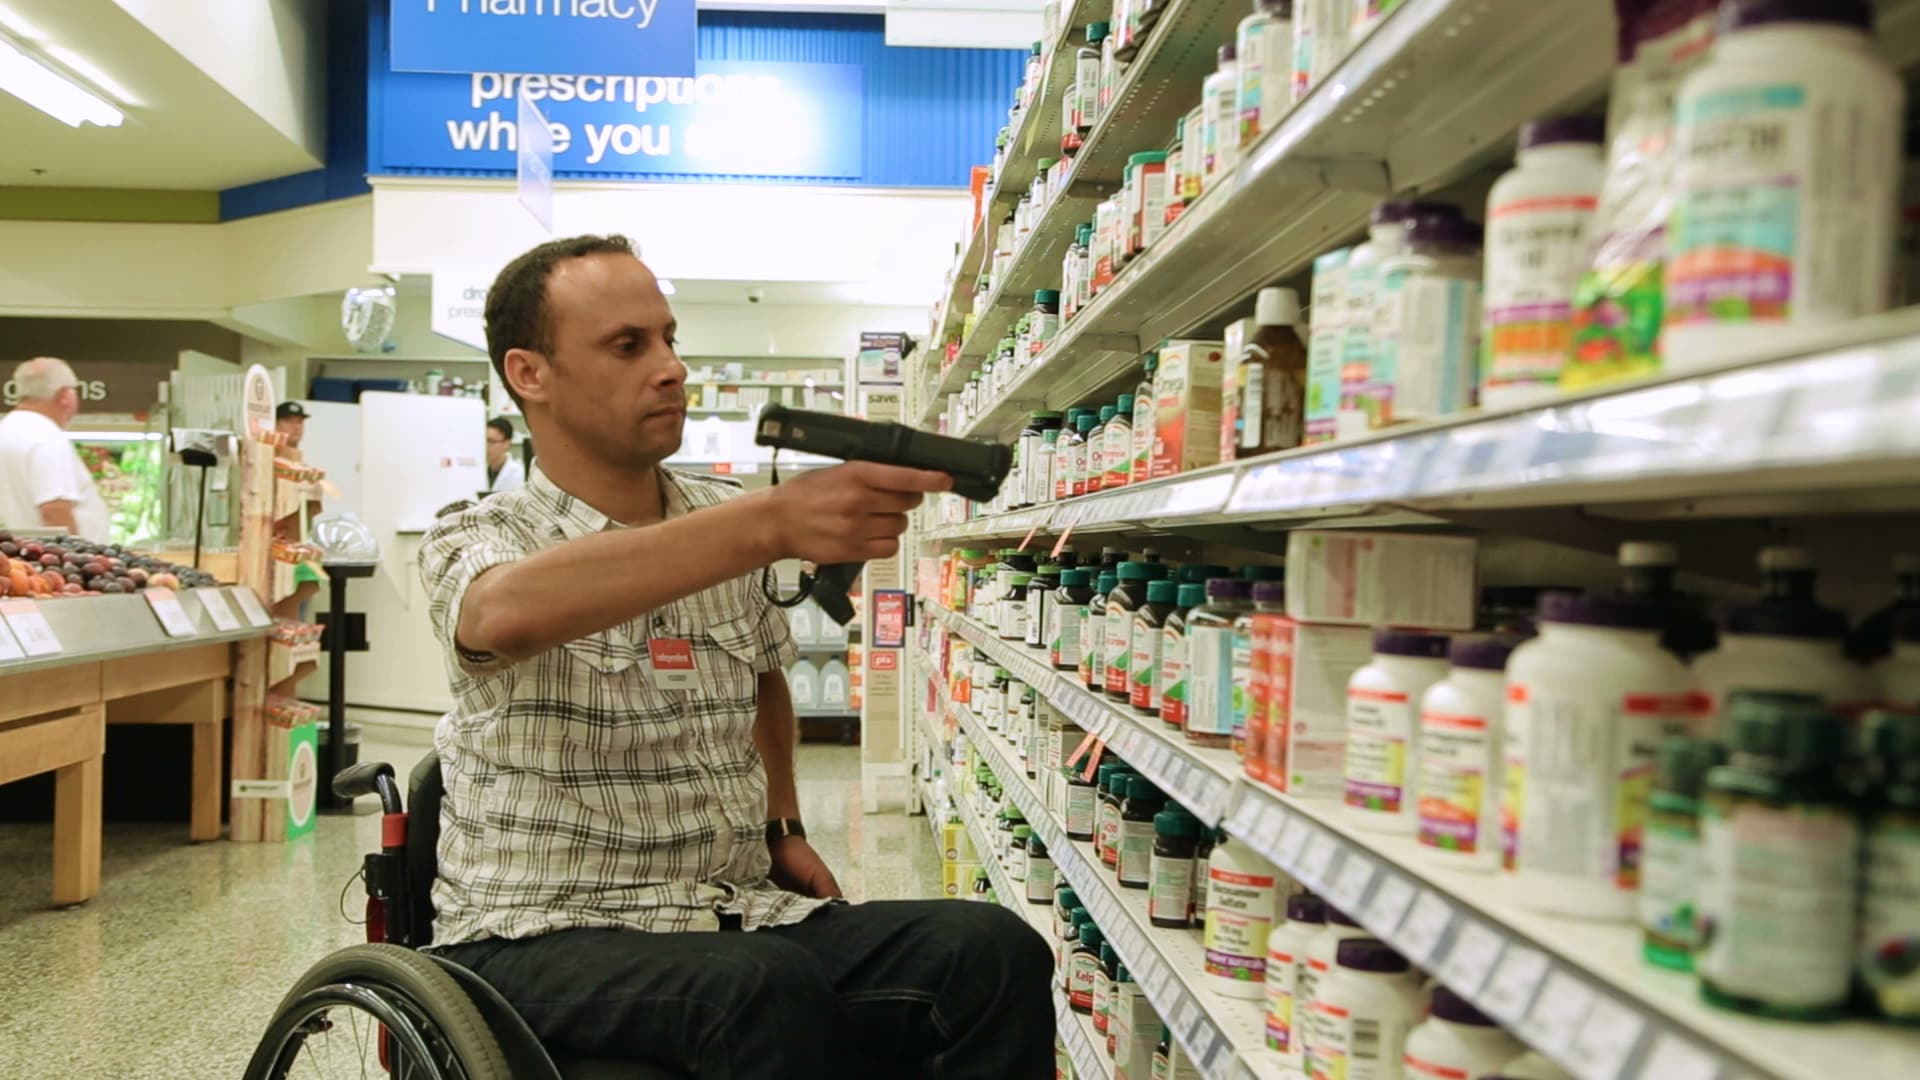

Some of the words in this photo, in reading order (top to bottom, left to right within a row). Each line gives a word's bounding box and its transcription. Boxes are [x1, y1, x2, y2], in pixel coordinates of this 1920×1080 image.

[427, 0, 659, 28] armacy
[471, 71, 782, 112] prescriptio
[446, 112, 572, 153] whe
[584, 122, 671, 164] you
[3, 380, 107, 406] gns
[1076, 970, 1094, 985] Kelp
